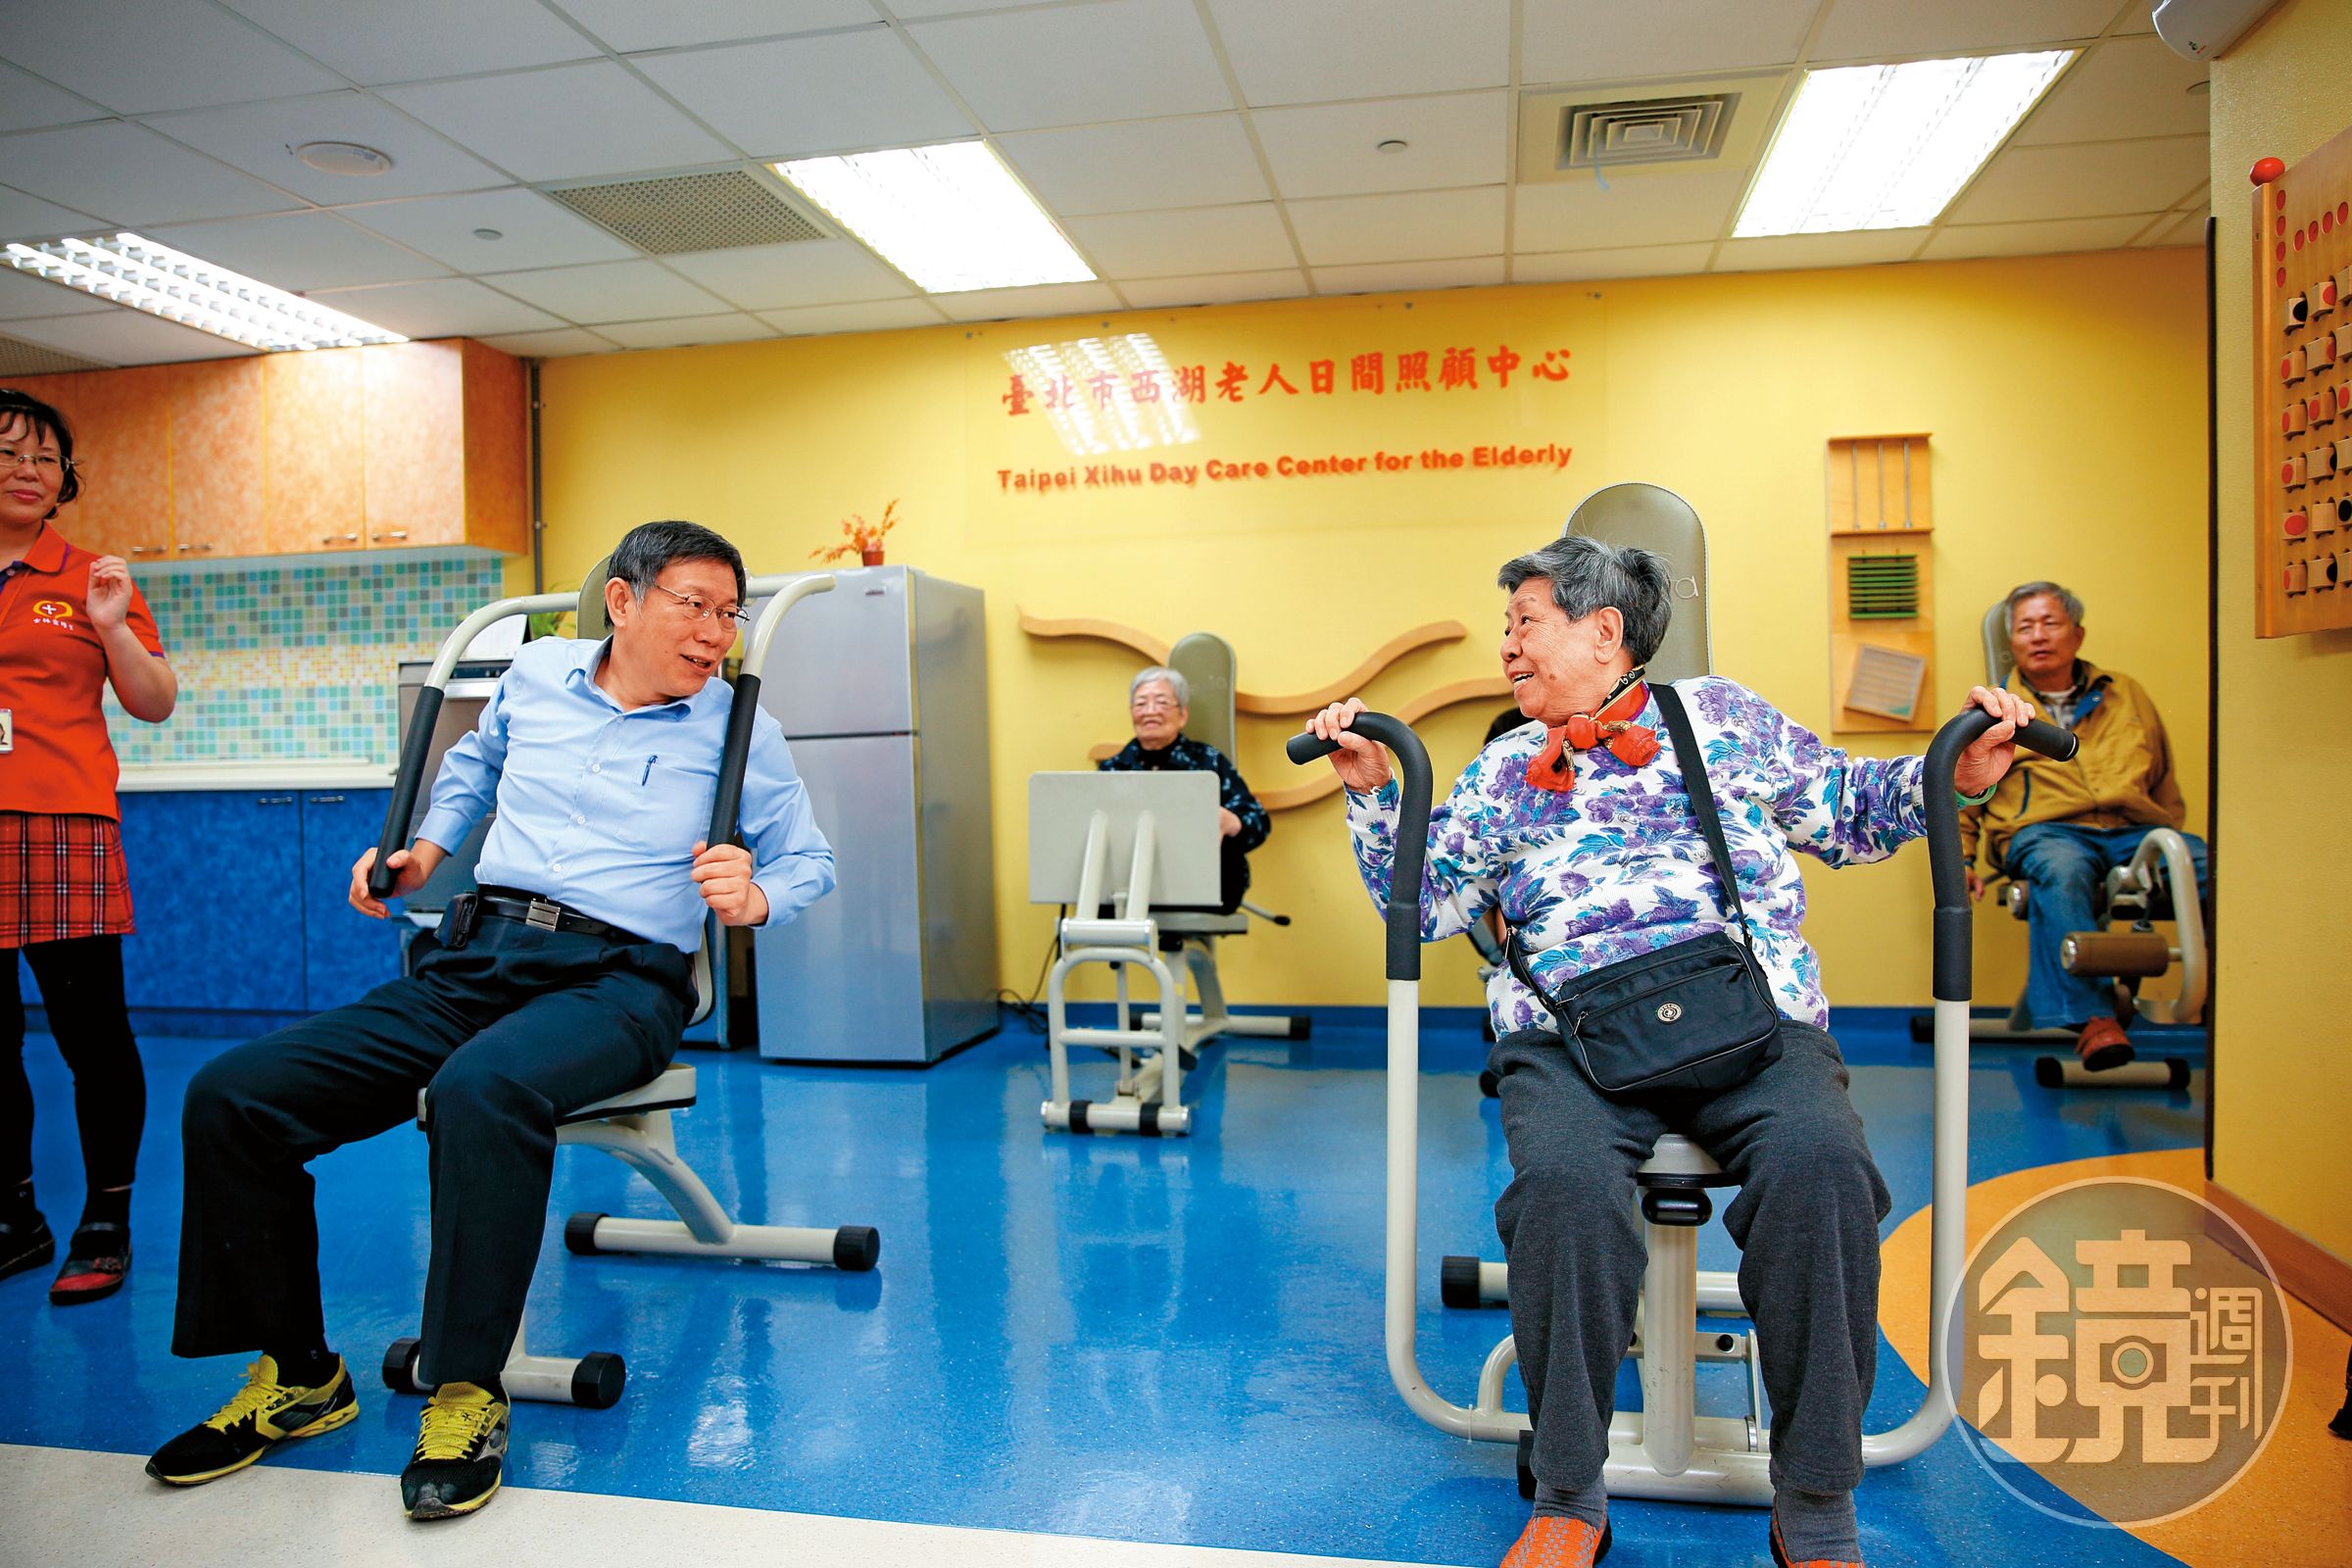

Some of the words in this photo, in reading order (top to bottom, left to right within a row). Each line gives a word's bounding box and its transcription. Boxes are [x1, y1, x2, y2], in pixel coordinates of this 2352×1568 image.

[1002, 344, 1573, 416] 臺北市西湖老人日間照顧中心
[998, 466, 1076, 493] Taipei
[1084, 466, 1142, 485] Xihu
[1150, 463, 1198, 484] Day
[1205, 460, 1269, 480] Care
[1276, 455, 1368, 476] Center
[1374, 451, 1413, 471] for
[1420, 449, 1464, 469] the
[1473, 444, 1572, 472] Elderly
